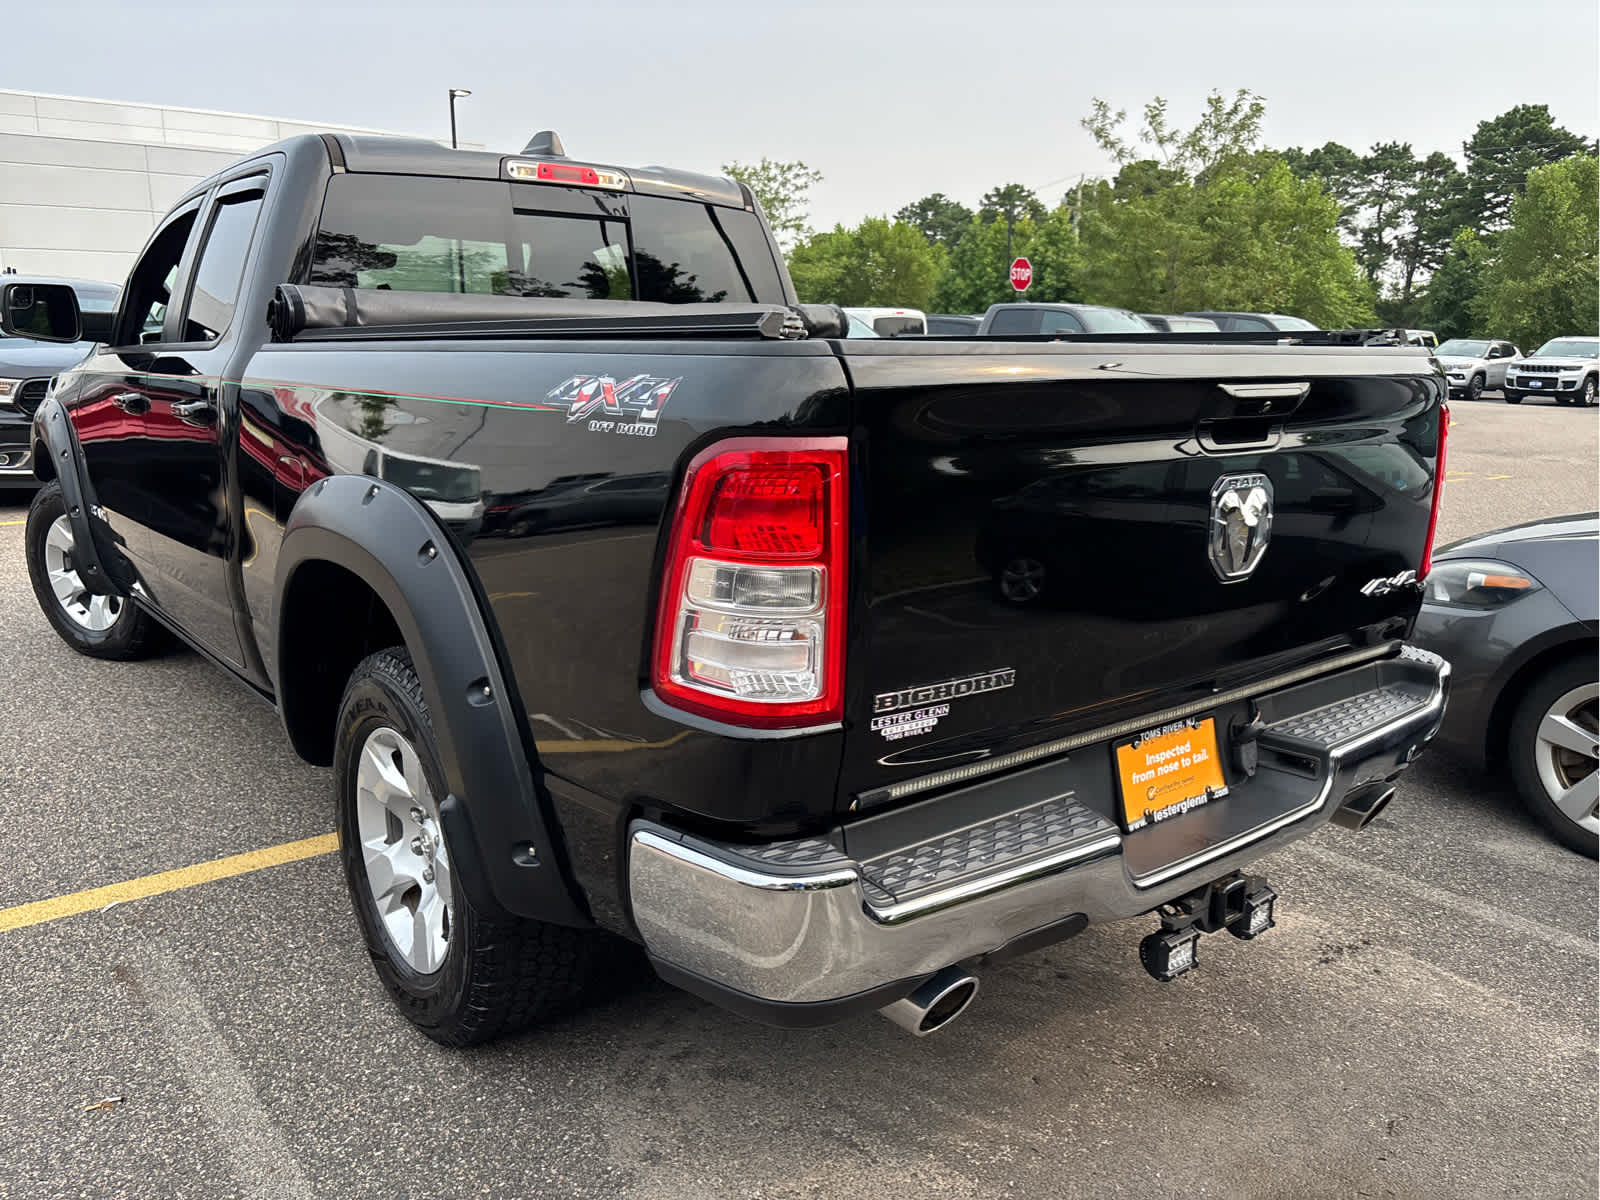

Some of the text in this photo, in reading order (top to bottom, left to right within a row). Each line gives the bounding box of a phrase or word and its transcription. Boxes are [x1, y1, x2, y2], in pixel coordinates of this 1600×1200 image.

[1011, 268, 1031, 281] STOP
[588, 420, 658, 437] OFF ROAD
[1228, 477, 1264, 490] RAM
[875, 669, 1016, 713] BIGHORN
[871, 704, 950, 730] LESTER GLENN
[1140, 727, 1161, 743] TOMS
[1186, 716, 1196, 728] NJ
[1145, 740, 1191, 766] Inspected
[1132, 749, 1209, 784] from nose to tail.
